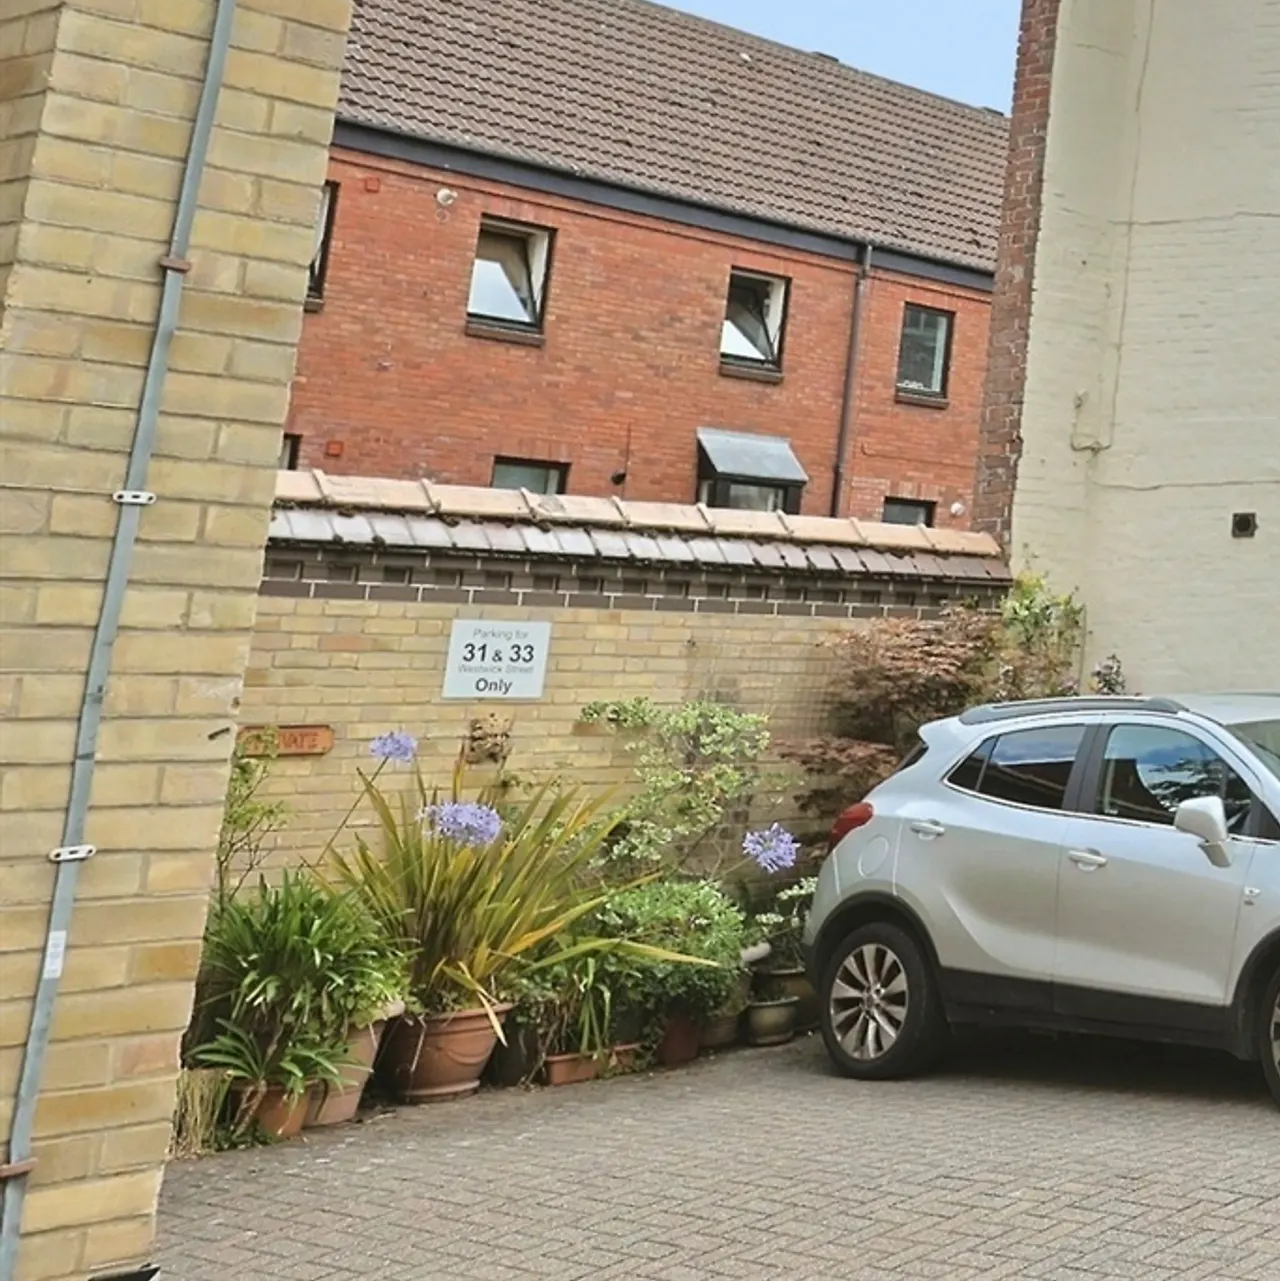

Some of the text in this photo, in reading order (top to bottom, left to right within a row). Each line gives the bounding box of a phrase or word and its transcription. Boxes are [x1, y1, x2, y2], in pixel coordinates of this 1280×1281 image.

[473, 628, 513, 641] Parking
[462, 643, 534, 663] 31 & 33
[505, 664, 534, 674] Street
[475, 677, 513, 695] Only
